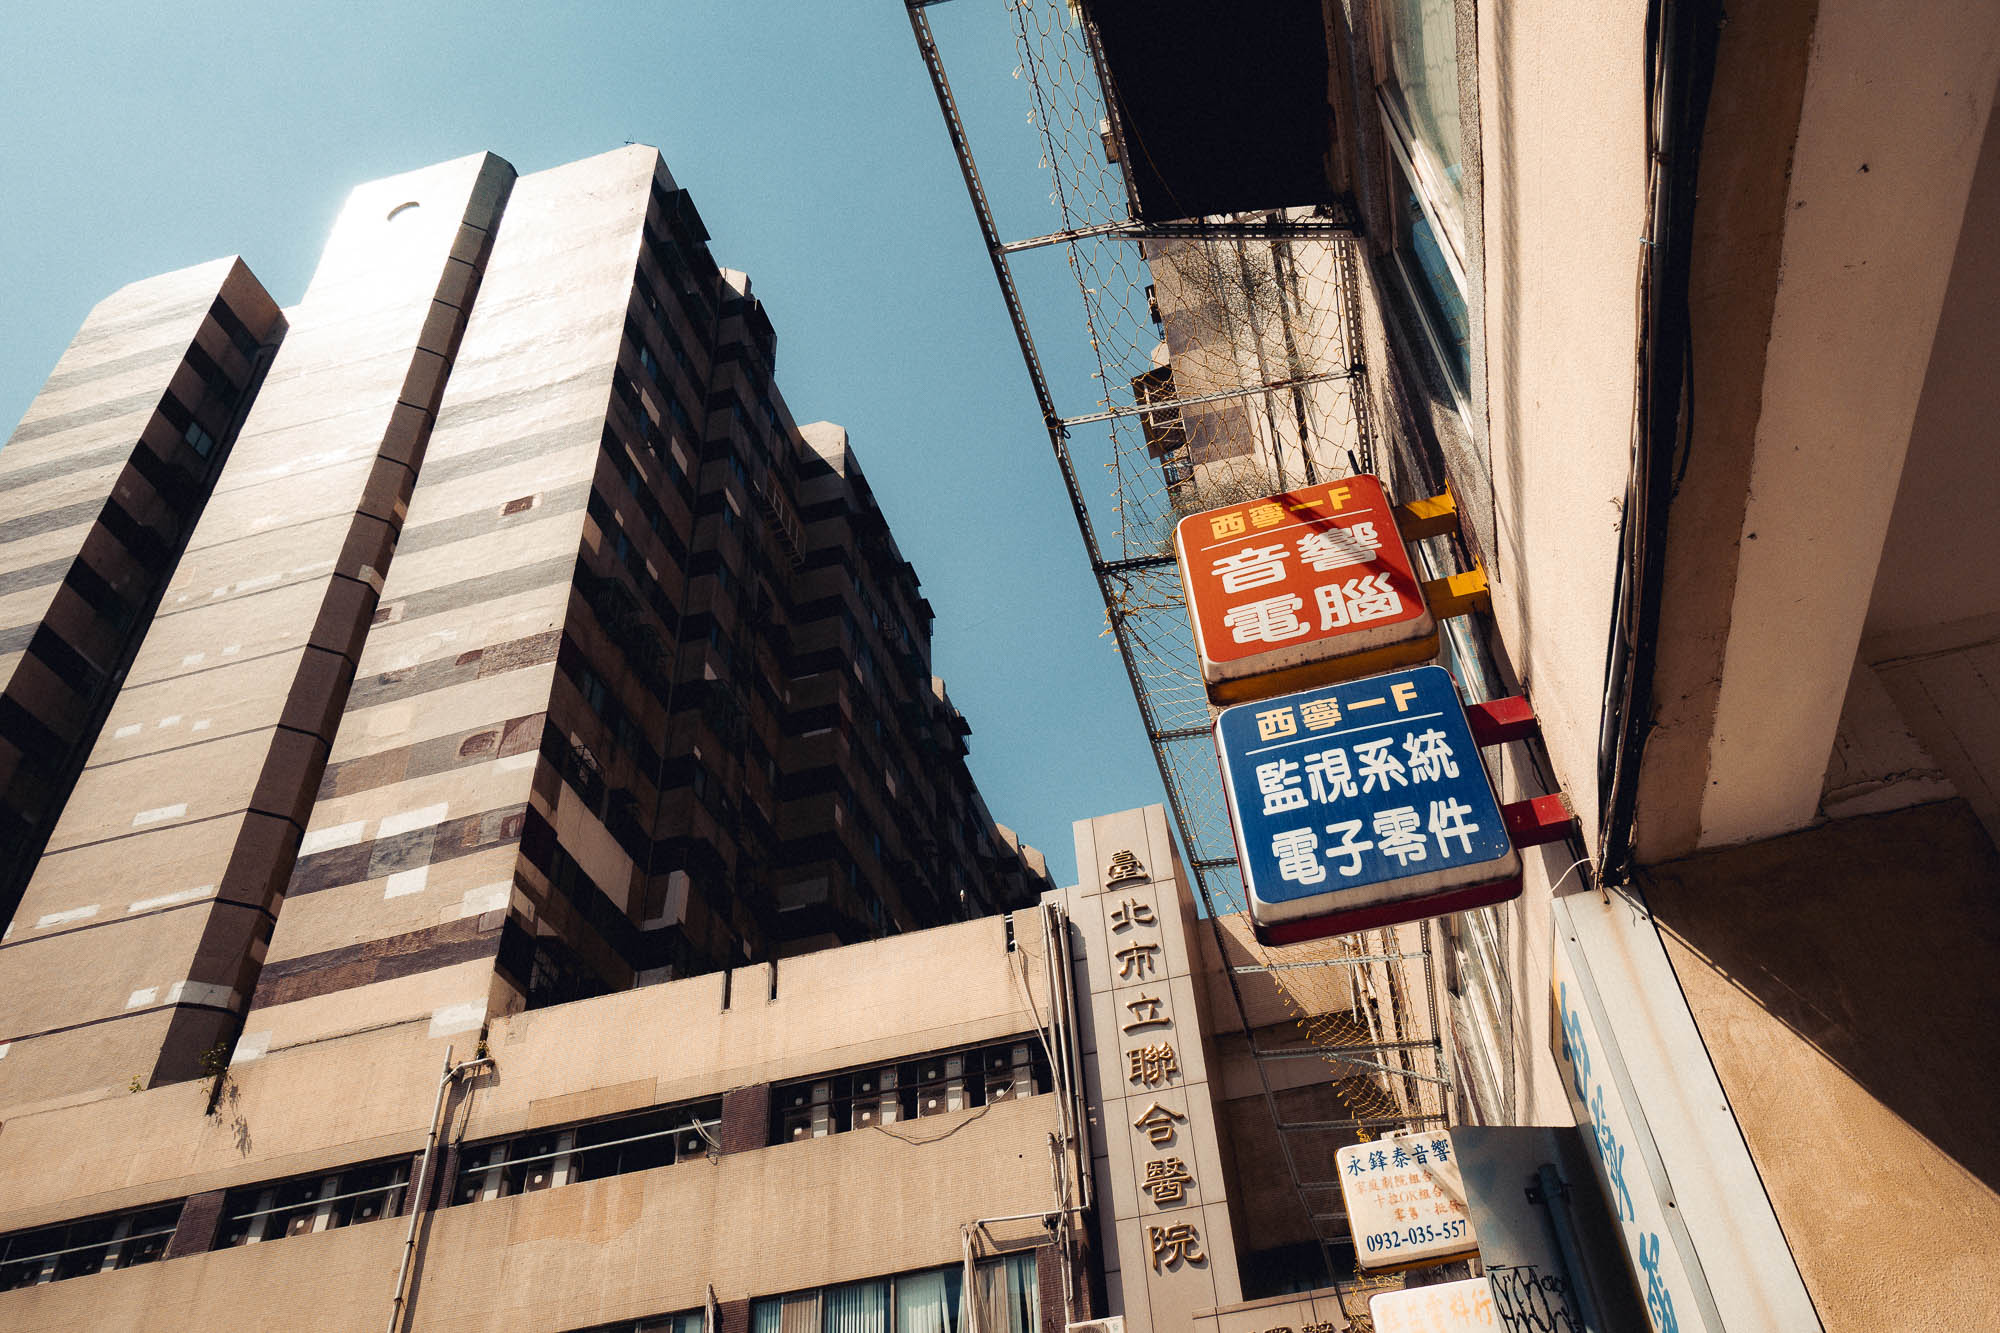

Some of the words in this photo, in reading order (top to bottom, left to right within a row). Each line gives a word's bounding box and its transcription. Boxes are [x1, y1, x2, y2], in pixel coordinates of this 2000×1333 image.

[1212, 522, 1383, 594] 音響
[1224, 573, 1403, 644] 電腦
[1256, 728, 1460, 816] 監視系統
[1272, 798, 1480, 886] 電子零件
[1105, 848, 1206, 1271] 臺北市立聯合醫院
[1347, 1138, 1451, 1176] 永鋒泰音響
[1366, 1219, 1467, 1252] 0932-035-557
